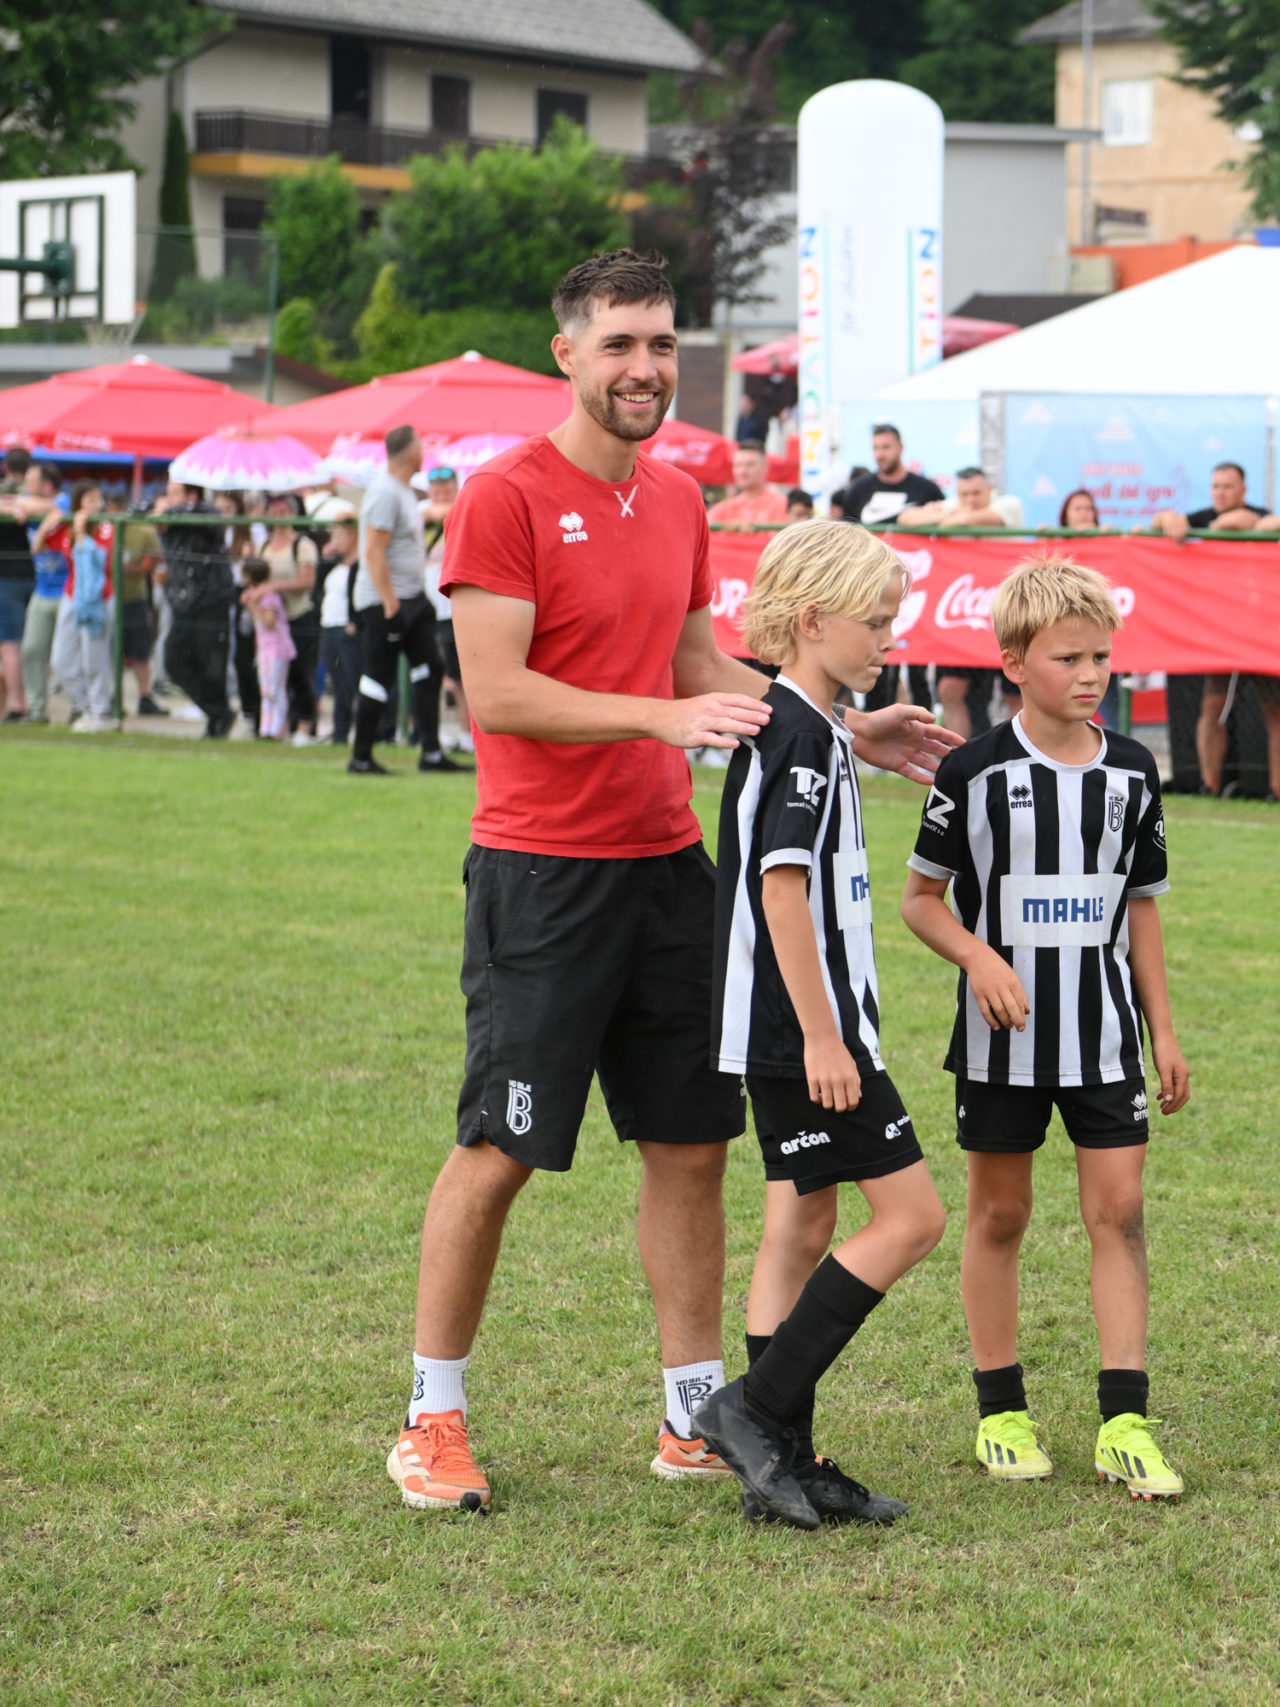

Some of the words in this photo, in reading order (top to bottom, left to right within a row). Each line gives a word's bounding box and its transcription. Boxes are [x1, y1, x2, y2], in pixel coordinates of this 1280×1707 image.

[562, 531, 589, 544] errea
[710, 578, 748, 618] UP
[1010, 800, 1033, 809] errea
[780, 1131, 831, 1155] arčon
